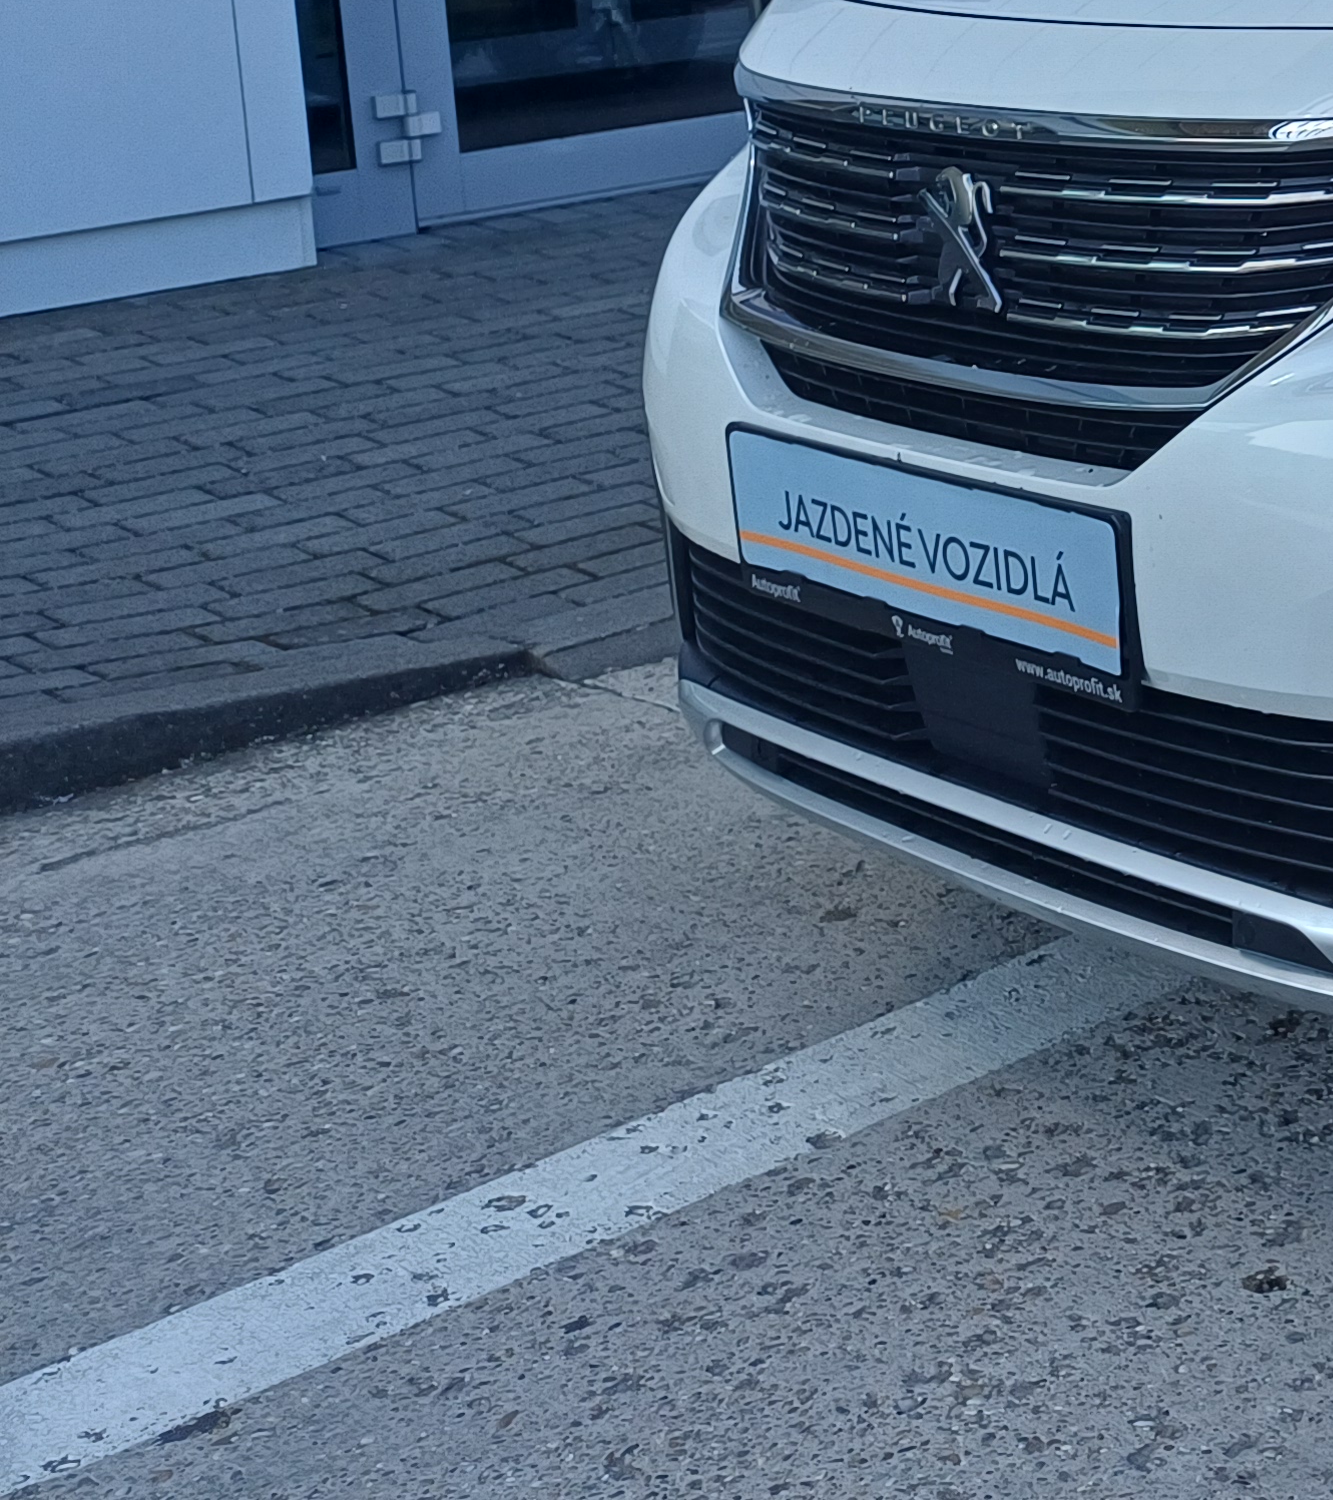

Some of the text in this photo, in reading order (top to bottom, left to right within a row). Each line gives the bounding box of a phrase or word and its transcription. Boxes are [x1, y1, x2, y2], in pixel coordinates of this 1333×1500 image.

[858, 106, 1033, 141] PEUGEOT
[778, 490, 1076, 613] JAZDENÉ VOZIDLÁ
[1015, 658, 1123, 703] www.autoprofit.sk
